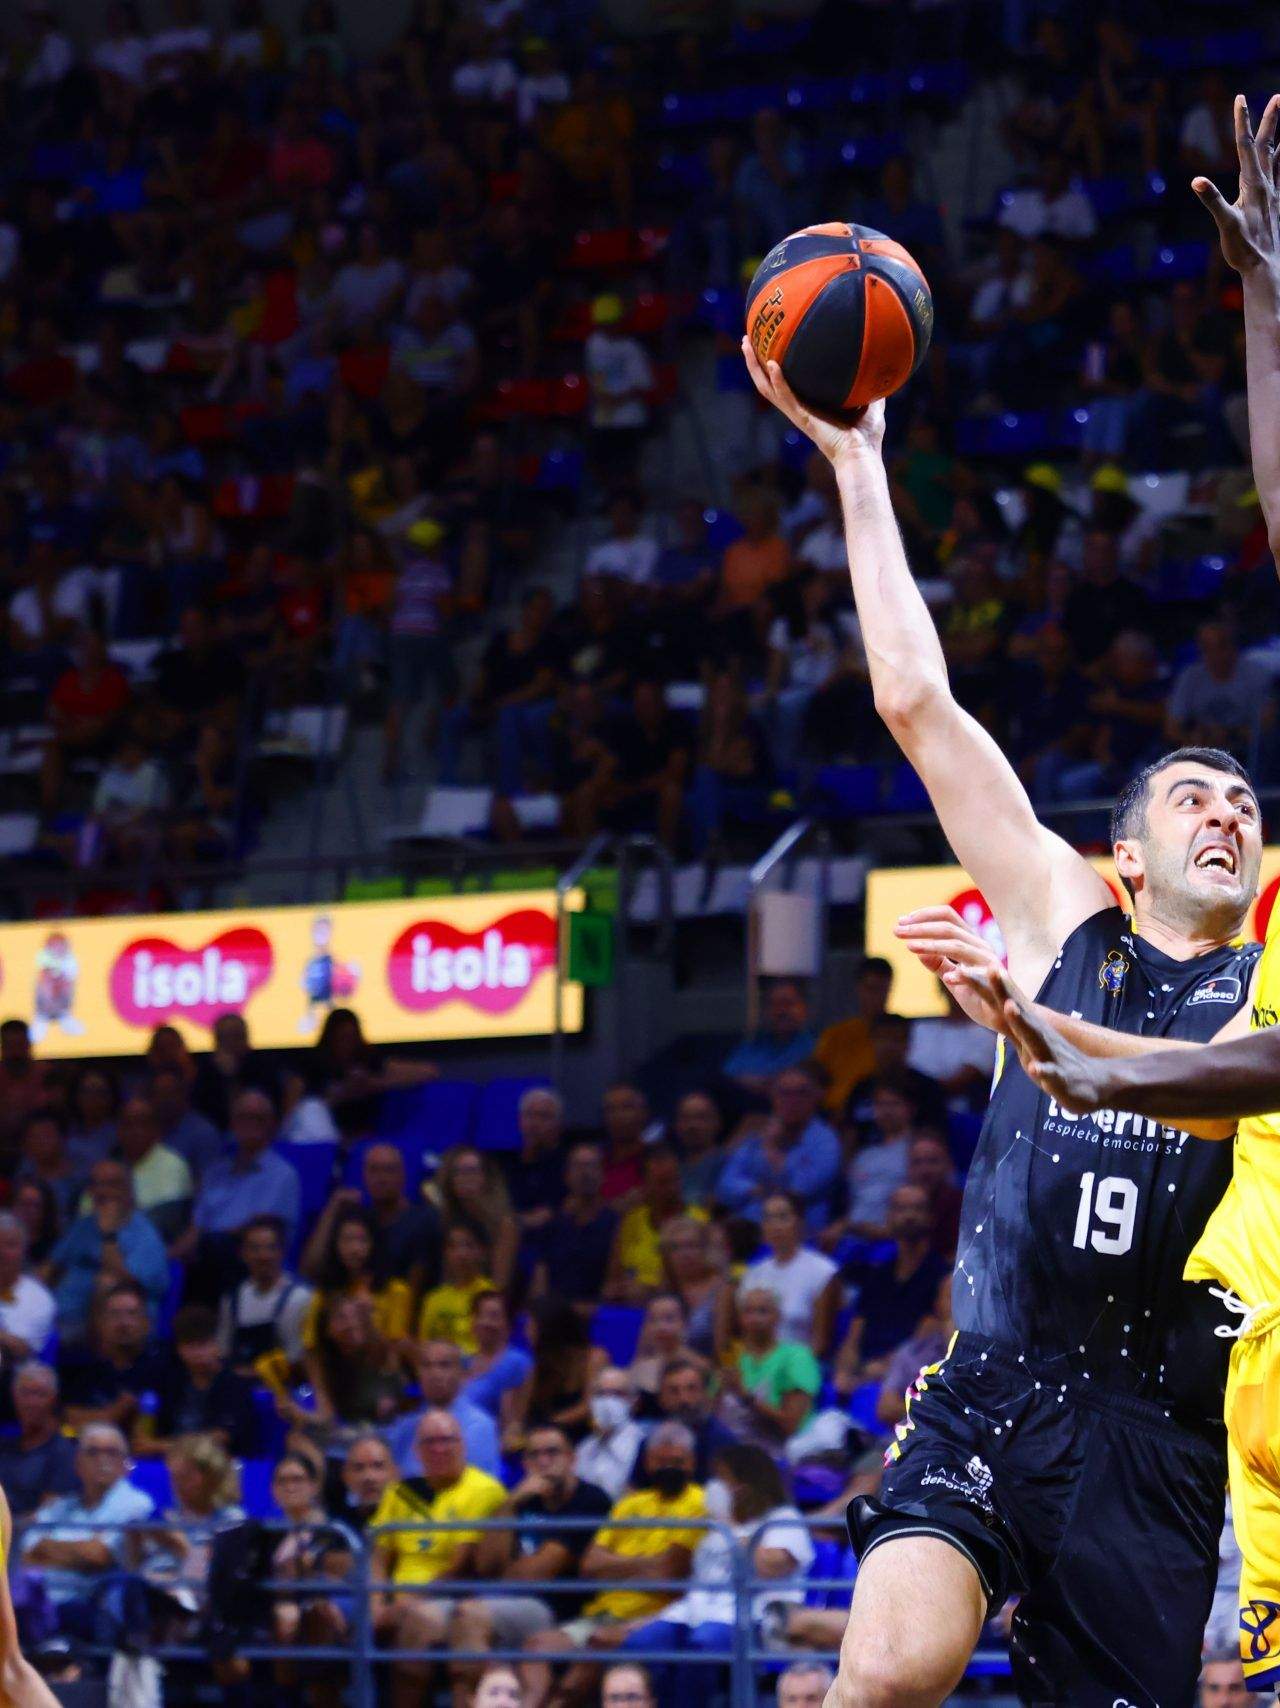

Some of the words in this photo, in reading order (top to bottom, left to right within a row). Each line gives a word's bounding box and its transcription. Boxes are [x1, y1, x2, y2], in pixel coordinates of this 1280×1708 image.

[133, 946, 248, 1009] isola
[411, 929, 531, 993] isola
[1073, 1171, 1138, 1256] 19
